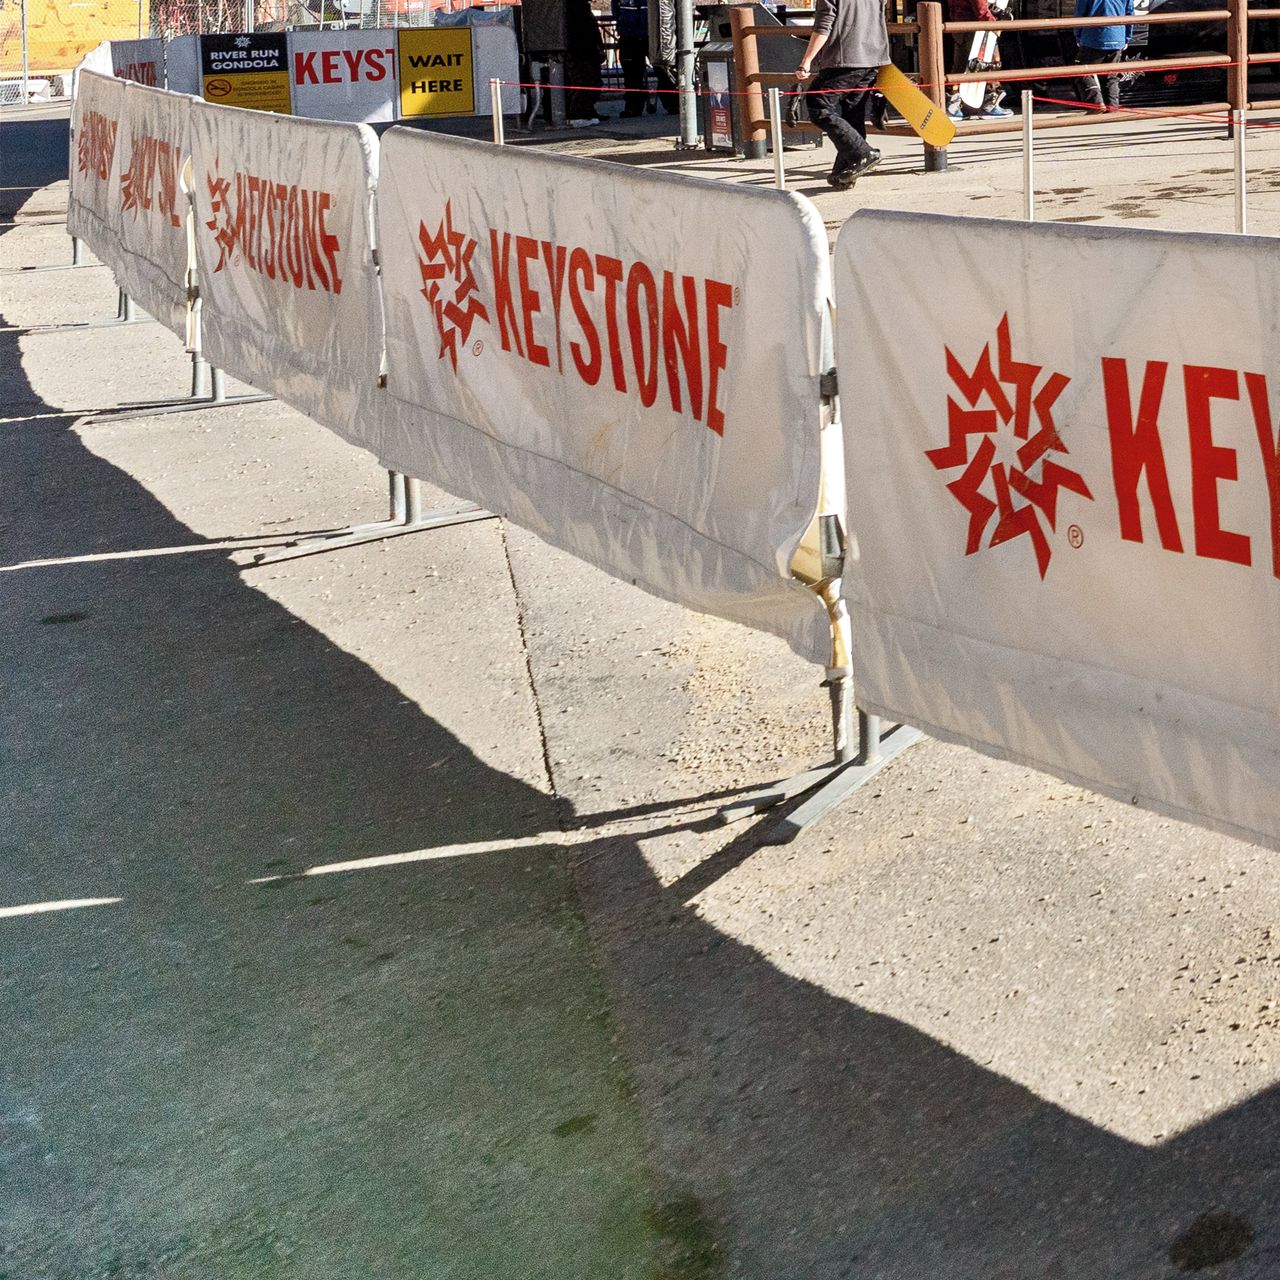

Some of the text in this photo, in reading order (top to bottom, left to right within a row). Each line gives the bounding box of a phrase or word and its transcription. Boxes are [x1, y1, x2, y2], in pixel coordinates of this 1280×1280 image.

[210, 49, 279, 60] RIVER RUN
[408, 53, 464, 68] WAIT
[212, 59, 279, 70] GONDOLA
[411, 79, 463, 94] HERE
